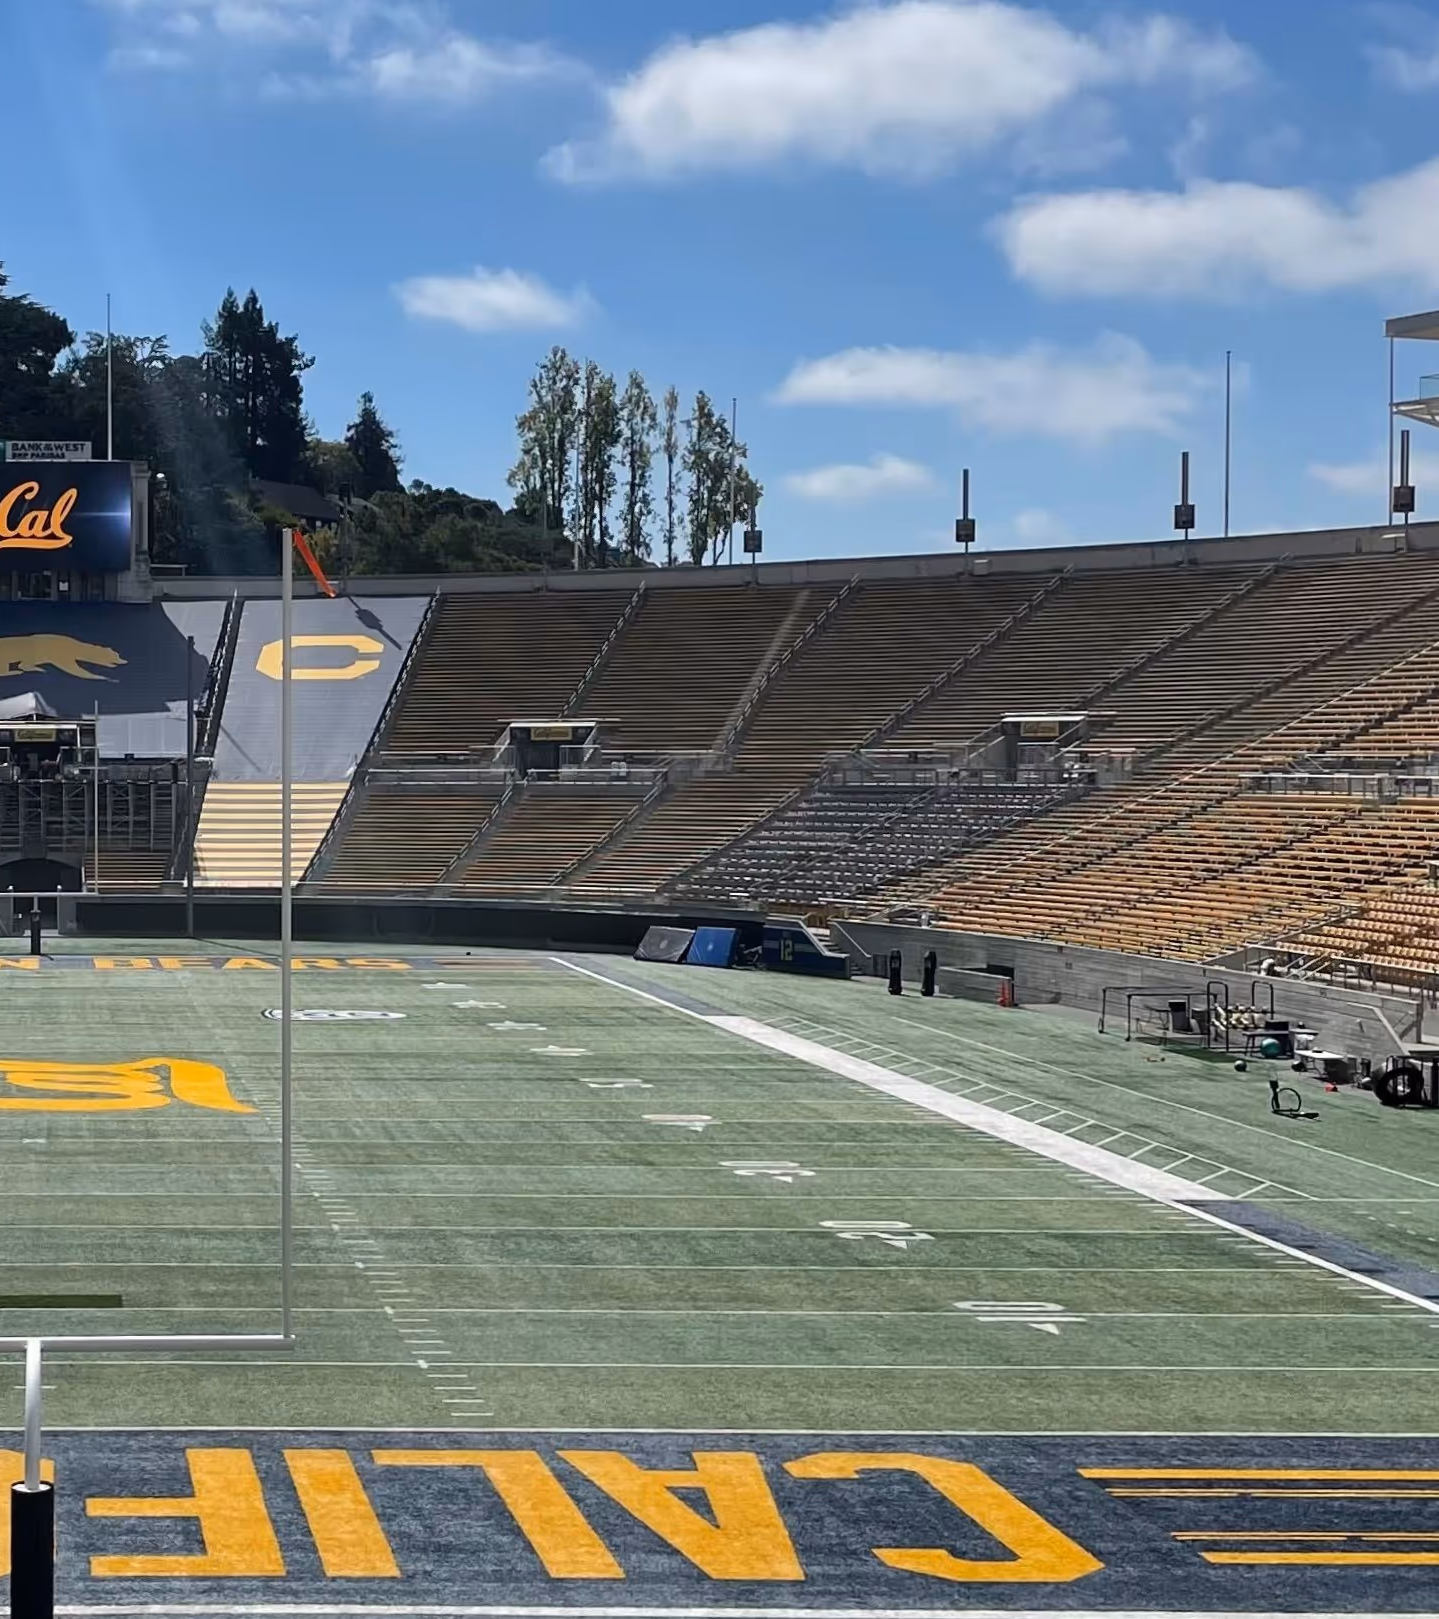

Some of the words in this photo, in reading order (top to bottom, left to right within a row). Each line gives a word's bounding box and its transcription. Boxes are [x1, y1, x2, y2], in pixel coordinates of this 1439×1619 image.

[54, 442, 87, 452] WEST
[255, 634, 385, 681] C
[92, 956, 412, 970] BEARS
